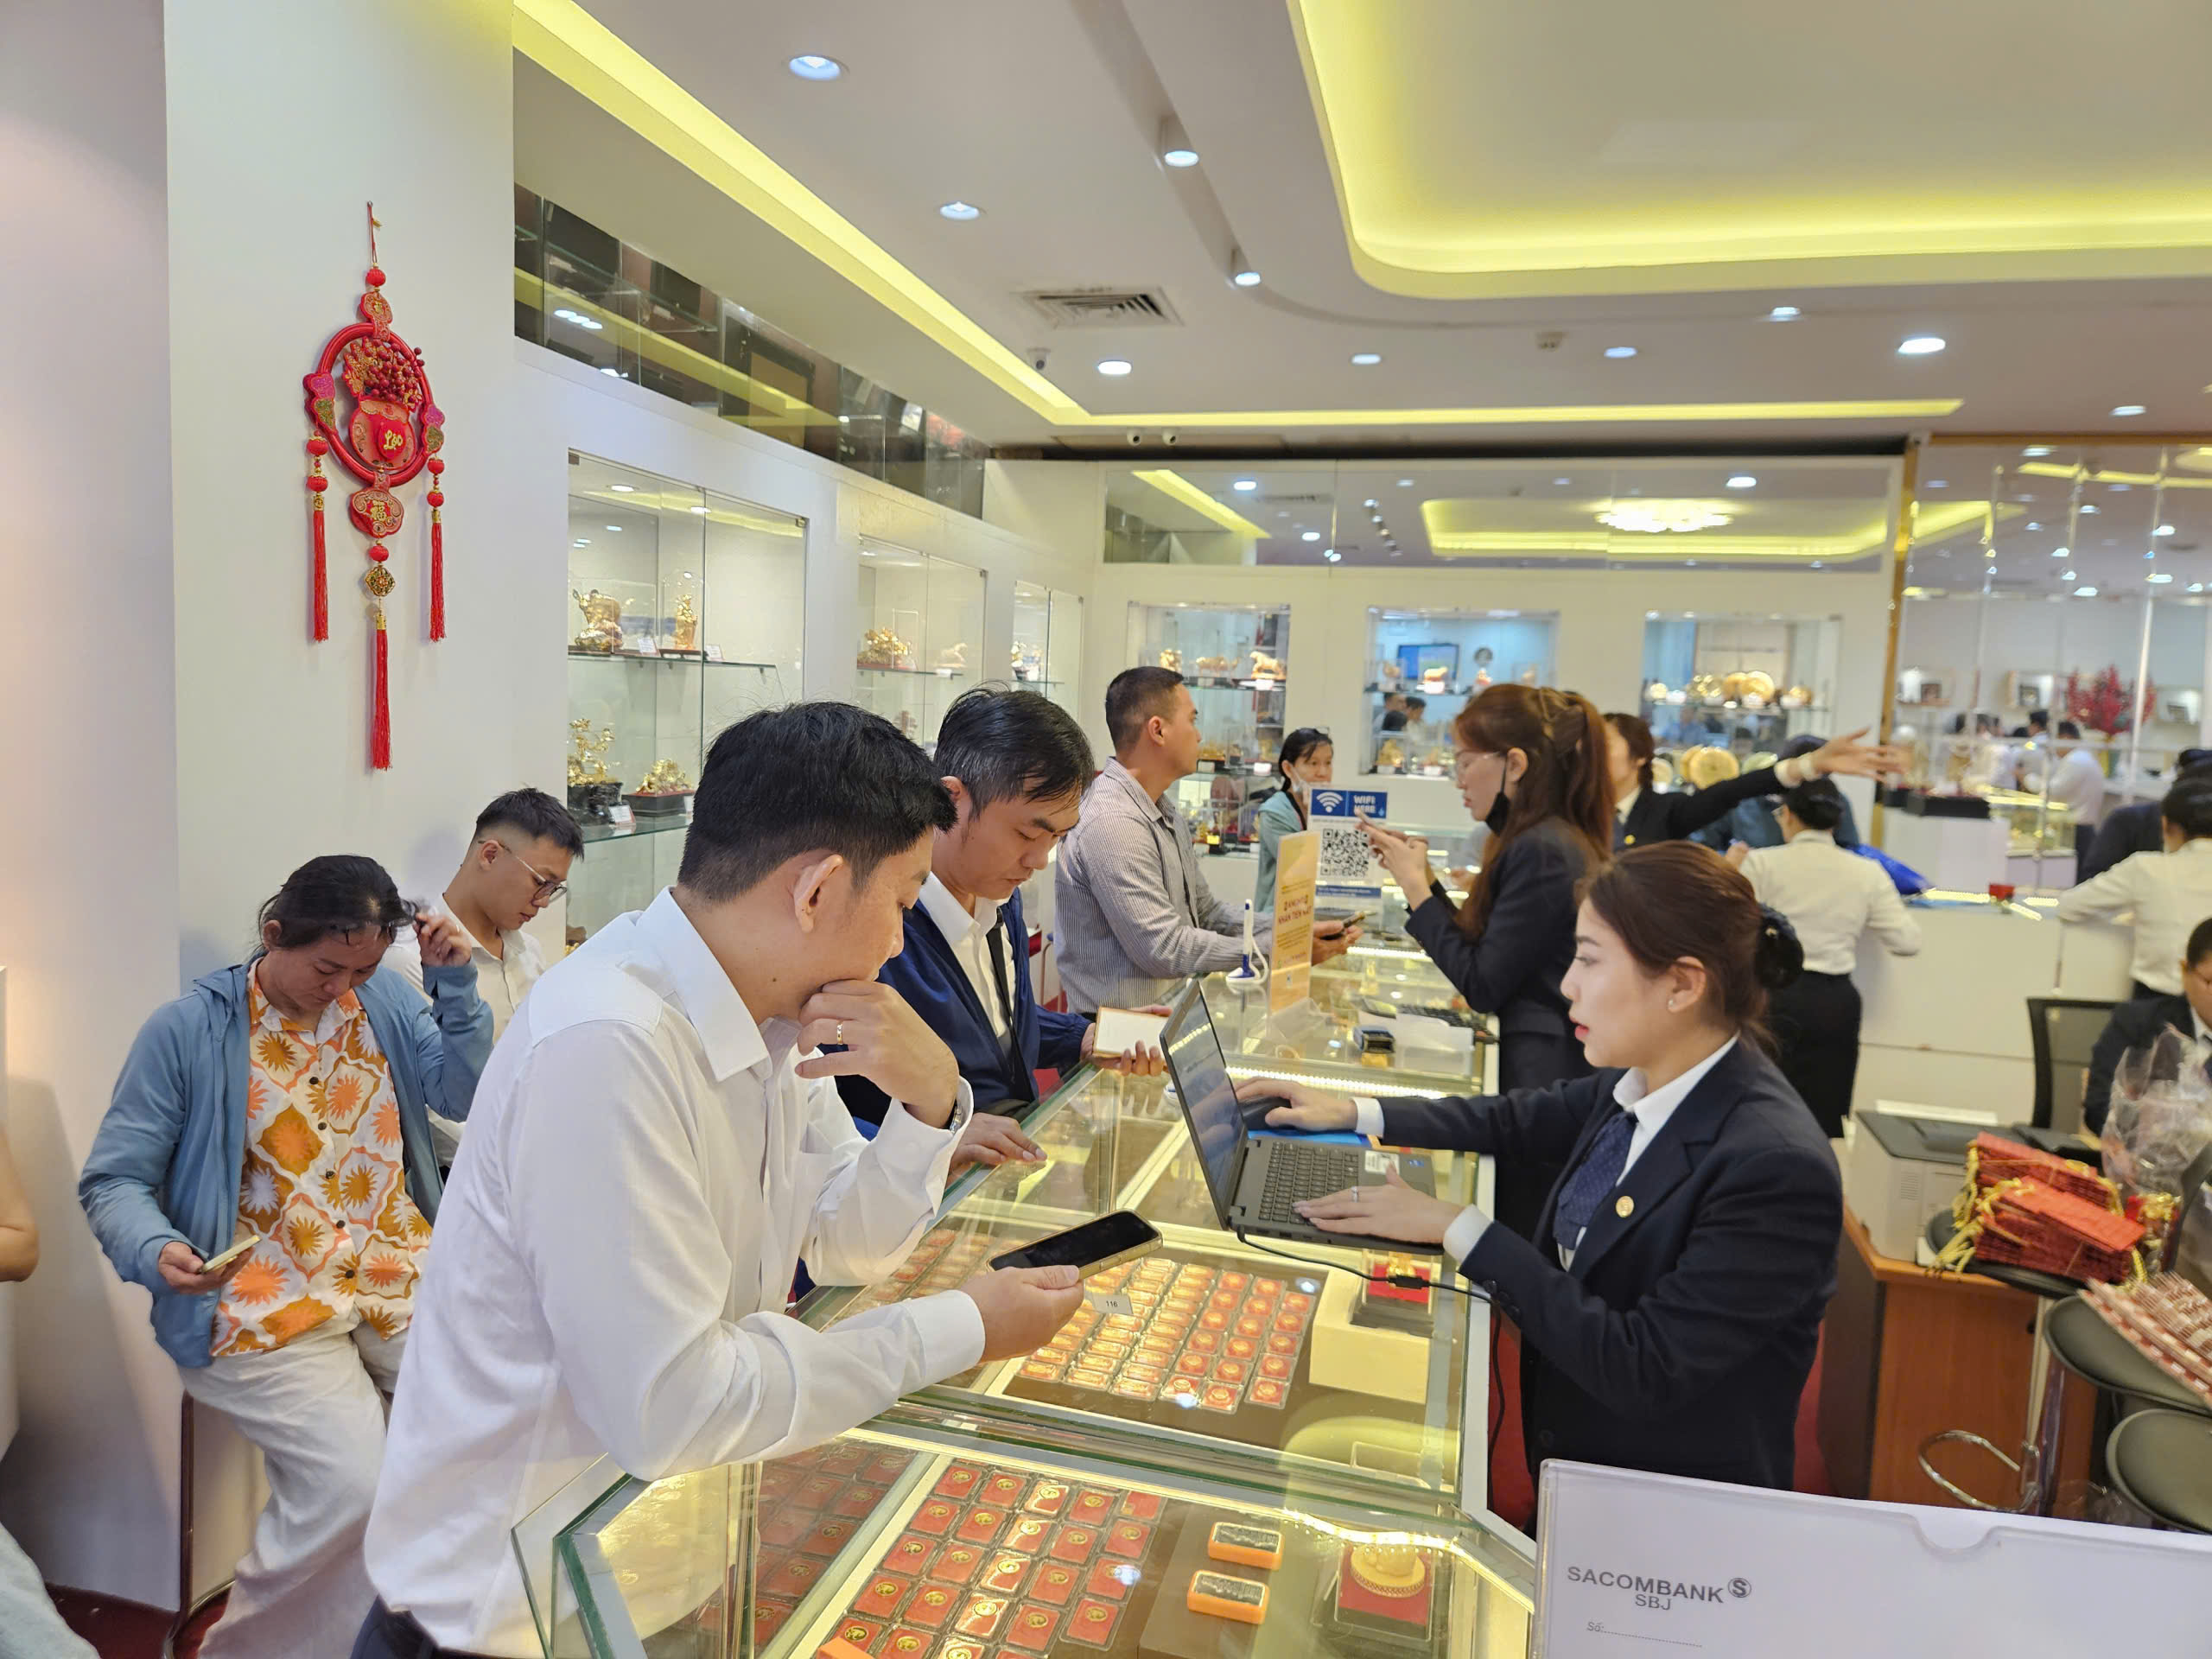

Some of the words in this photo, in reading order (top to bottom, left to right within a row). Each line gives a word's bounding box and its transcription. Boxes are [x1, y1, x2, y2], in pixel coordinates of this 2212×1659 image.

[1354, 795, 1376, 804] WIFI
[1567, 1566, 1724, 1604] SACOMBANK
[1635, 1594, 1672, 1611] SBJ
